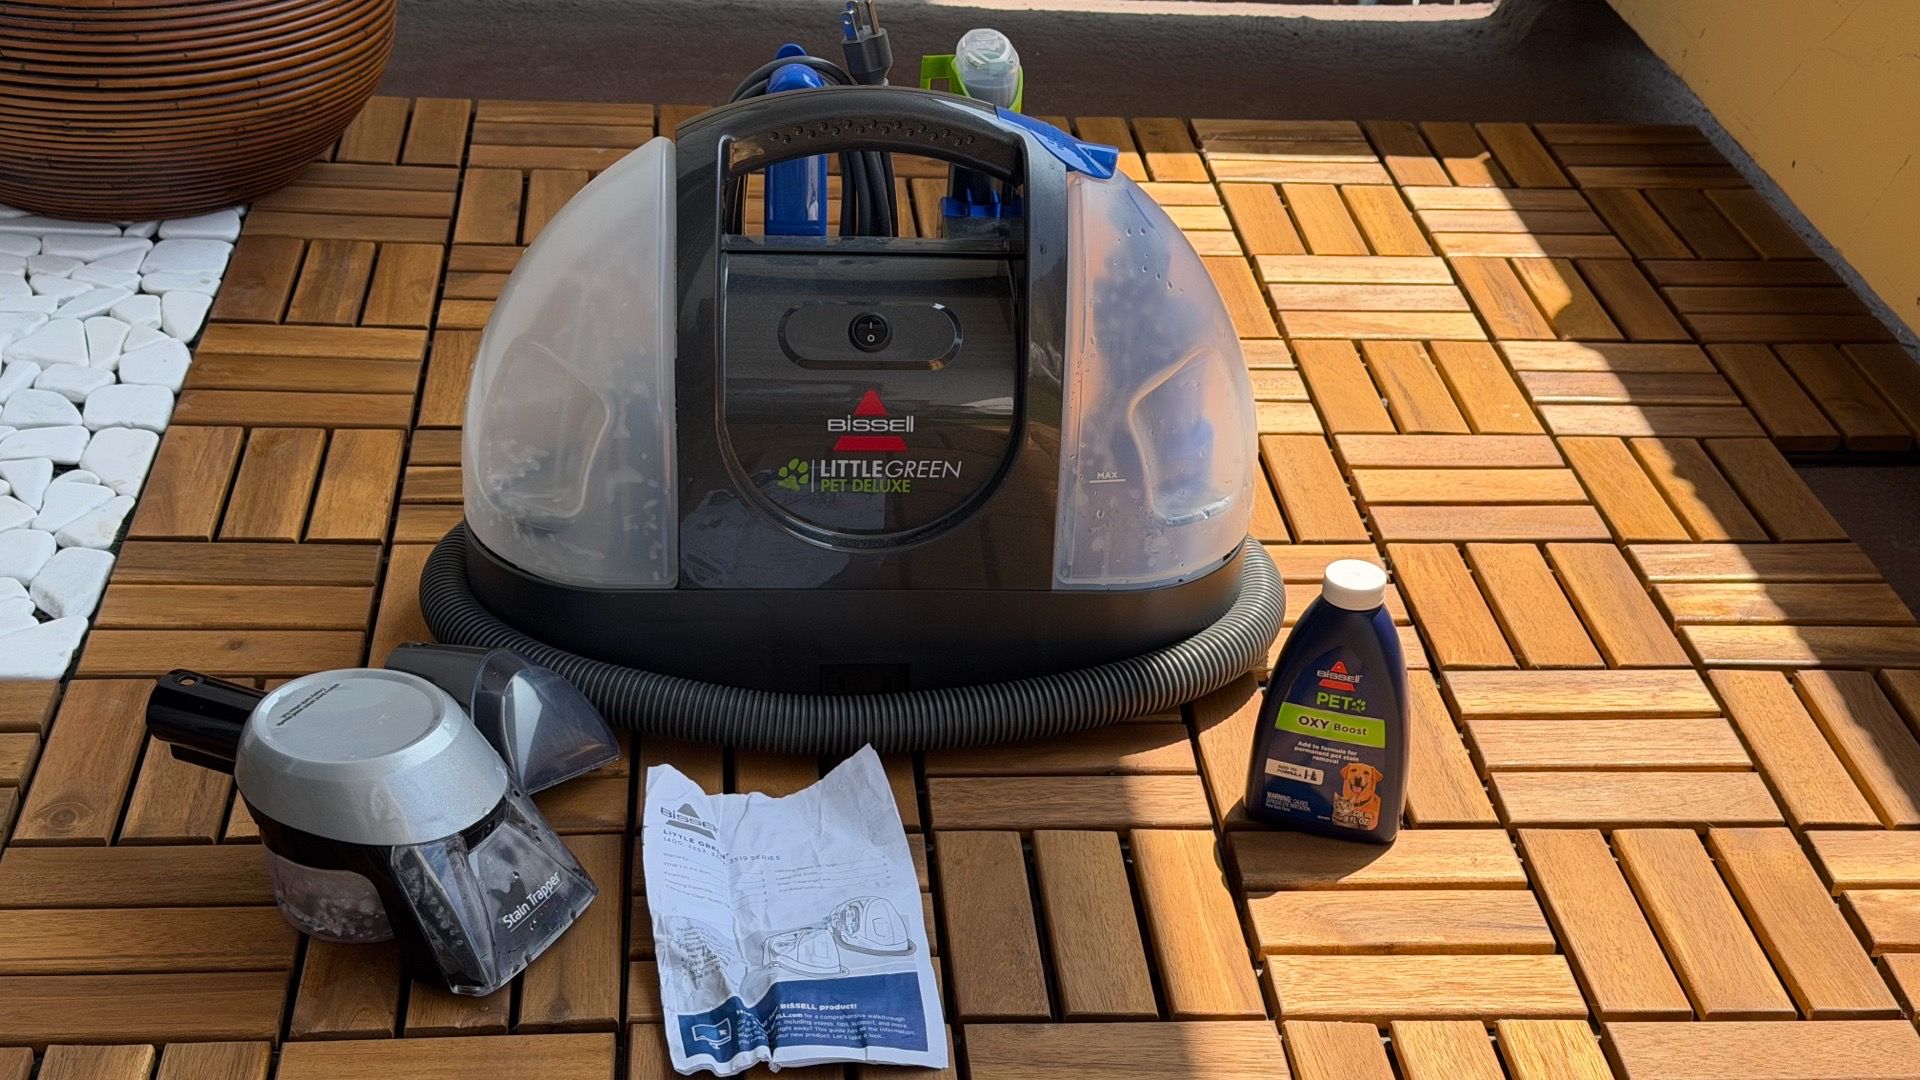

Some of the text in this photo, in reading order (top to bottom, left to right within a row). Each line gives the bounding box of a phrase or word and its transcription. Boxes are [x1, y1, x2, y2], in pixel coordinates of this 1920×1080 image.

[1097, 471, 1118, 479] MAX
[820, 479, 911, 492] PET DELUXE
[1316, 691, 1353, 710] PET
[1298, 715, 1367, 736] OXY Boost
[1294, 746, 1359, 762] permanent pet stain
[1297, 741, 1312, 749] Add
[1320, 745, 1347, 755] formula
[1312, 755, 1339, 765] removal
[1276, 768, 1303, 778] FORMULA
[663, 829, 695, 843] LITTLE
[502, 871, 560, 929] Stain Trapper
[819, 1003, 858, 1011] product!
